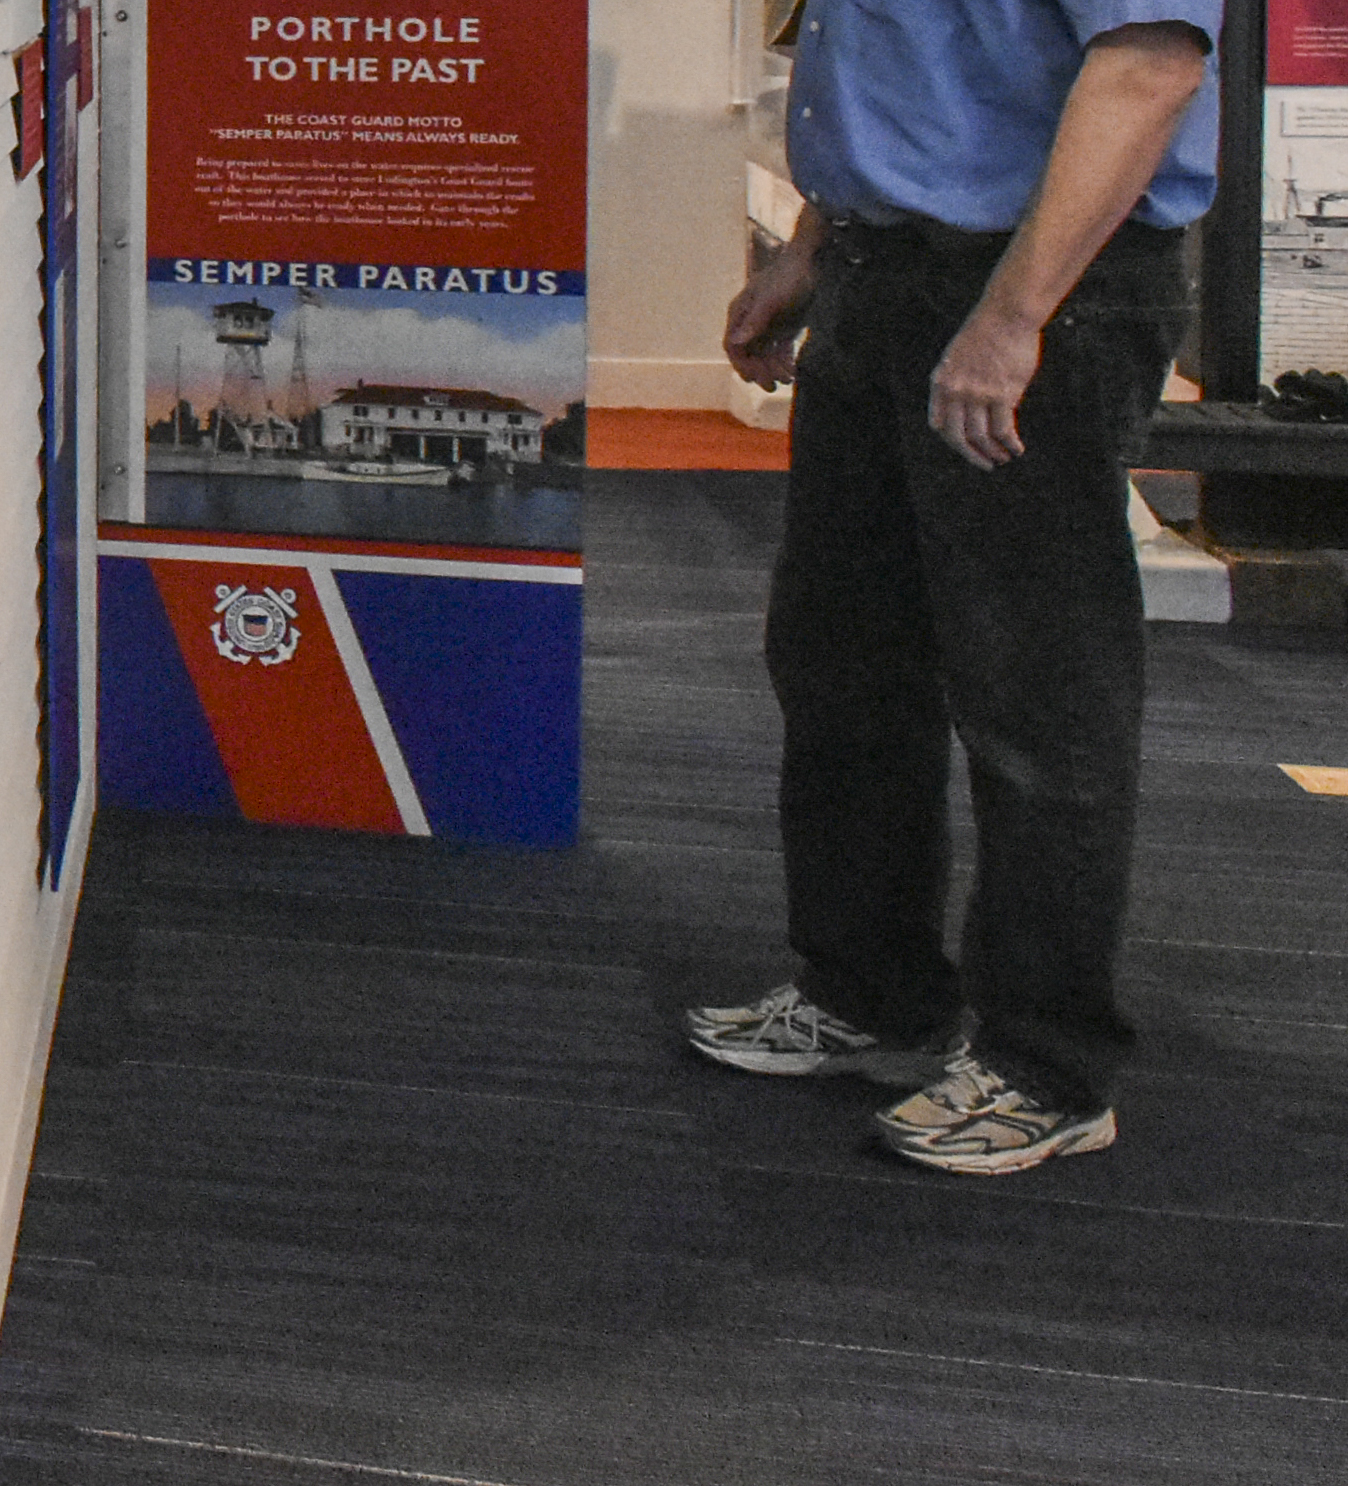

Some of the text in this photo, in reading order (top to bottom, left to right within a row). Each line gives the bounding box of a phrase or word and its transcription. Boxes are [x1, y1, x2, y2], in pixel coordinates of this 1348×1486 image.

[250, 15, 481, 44] PORTHOLE
[245, 55, 485, 85] TO THE PAST
[264, 113, 463, 129] THE COAST GUARD MOTTO
[352, 130, 405, 143] MEANS
[406, 131, 466, 144] ALWAYS
[173, 259, 559, 296] SEMPER PARATUS
